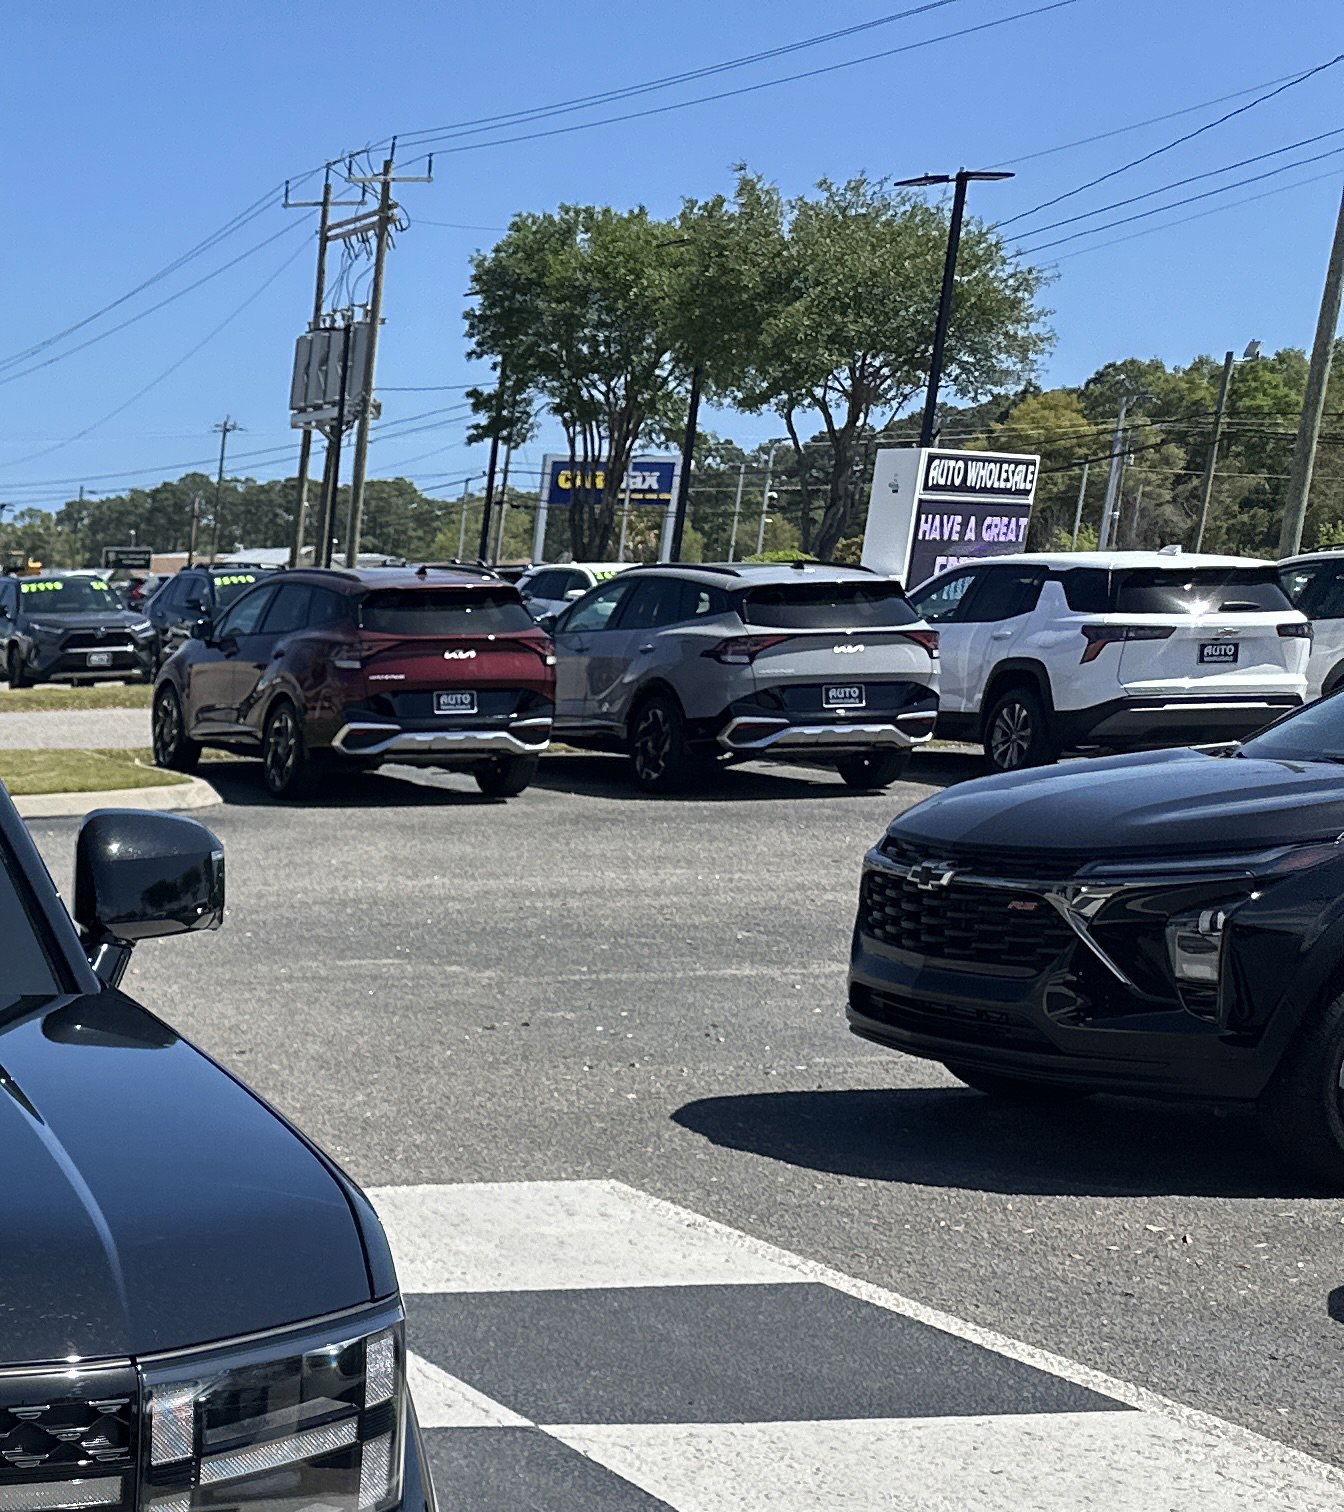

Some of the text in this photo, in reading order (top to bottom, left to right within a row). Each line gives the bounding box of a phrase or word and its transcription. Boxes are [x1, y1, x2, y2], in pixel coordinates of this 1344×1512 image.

[928, 459, 1035, 491] AUTO WHOLESALE
[918, 514, 1029, 541] HAVE A GREAT
[1204, 644, 1235, 656] AUTO
[828, 687, 860, 699] AUTO
[439, 694, 471, 705] AUTO
